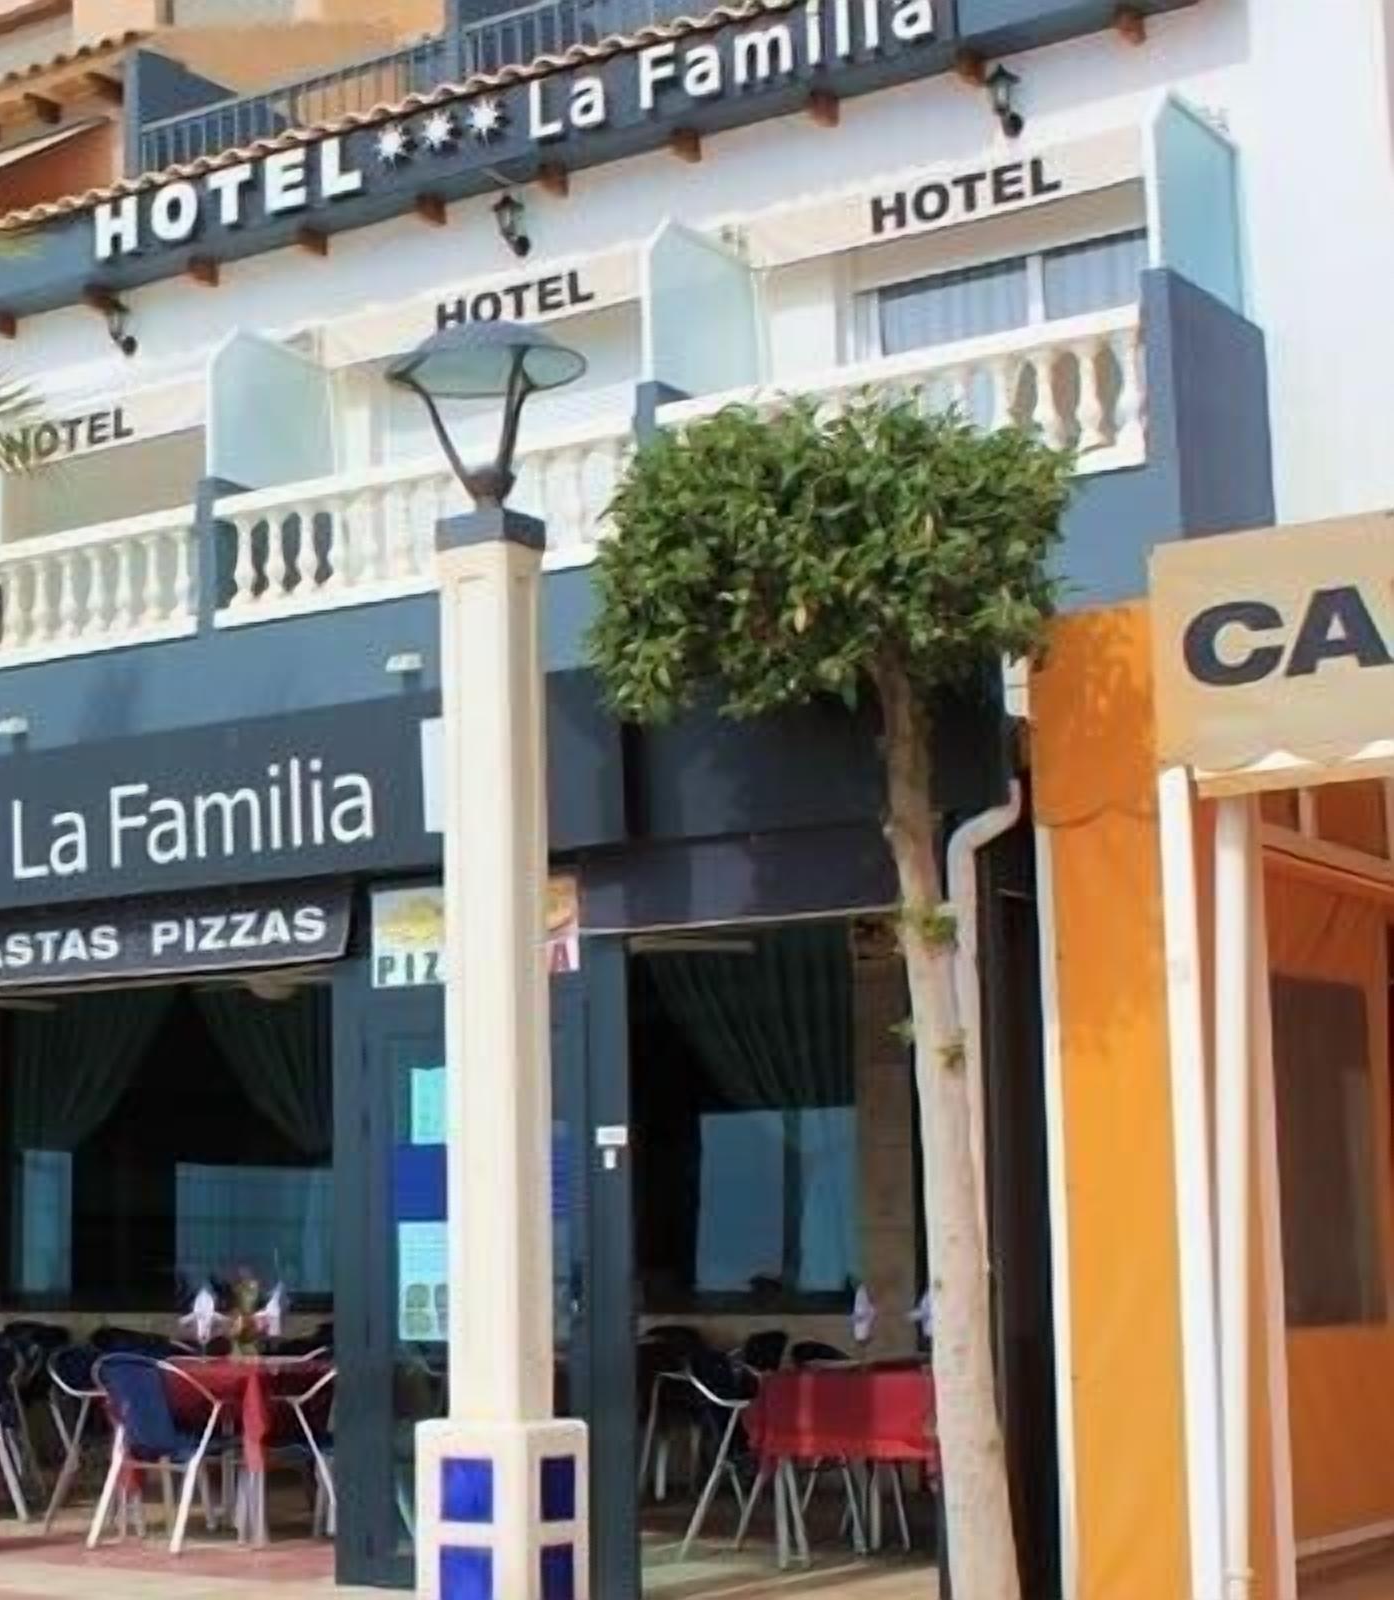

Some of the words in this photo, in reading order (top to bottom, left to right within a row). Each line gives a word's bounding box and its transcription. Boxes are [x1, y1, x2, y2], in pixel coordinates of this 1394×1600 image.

[94, 137, 362, 260] HOTEL
[529, 79, 605, 138] La
[639, 0, 934, 109] Familia
[870, 157, 1062, 233] HOTEL
[436, 269, 595, 331] HOTEL
[12, 799, 88, 880] La
[109, 756, 375, 868] Familia
[151, 906, 327, 956] PIZZAS
